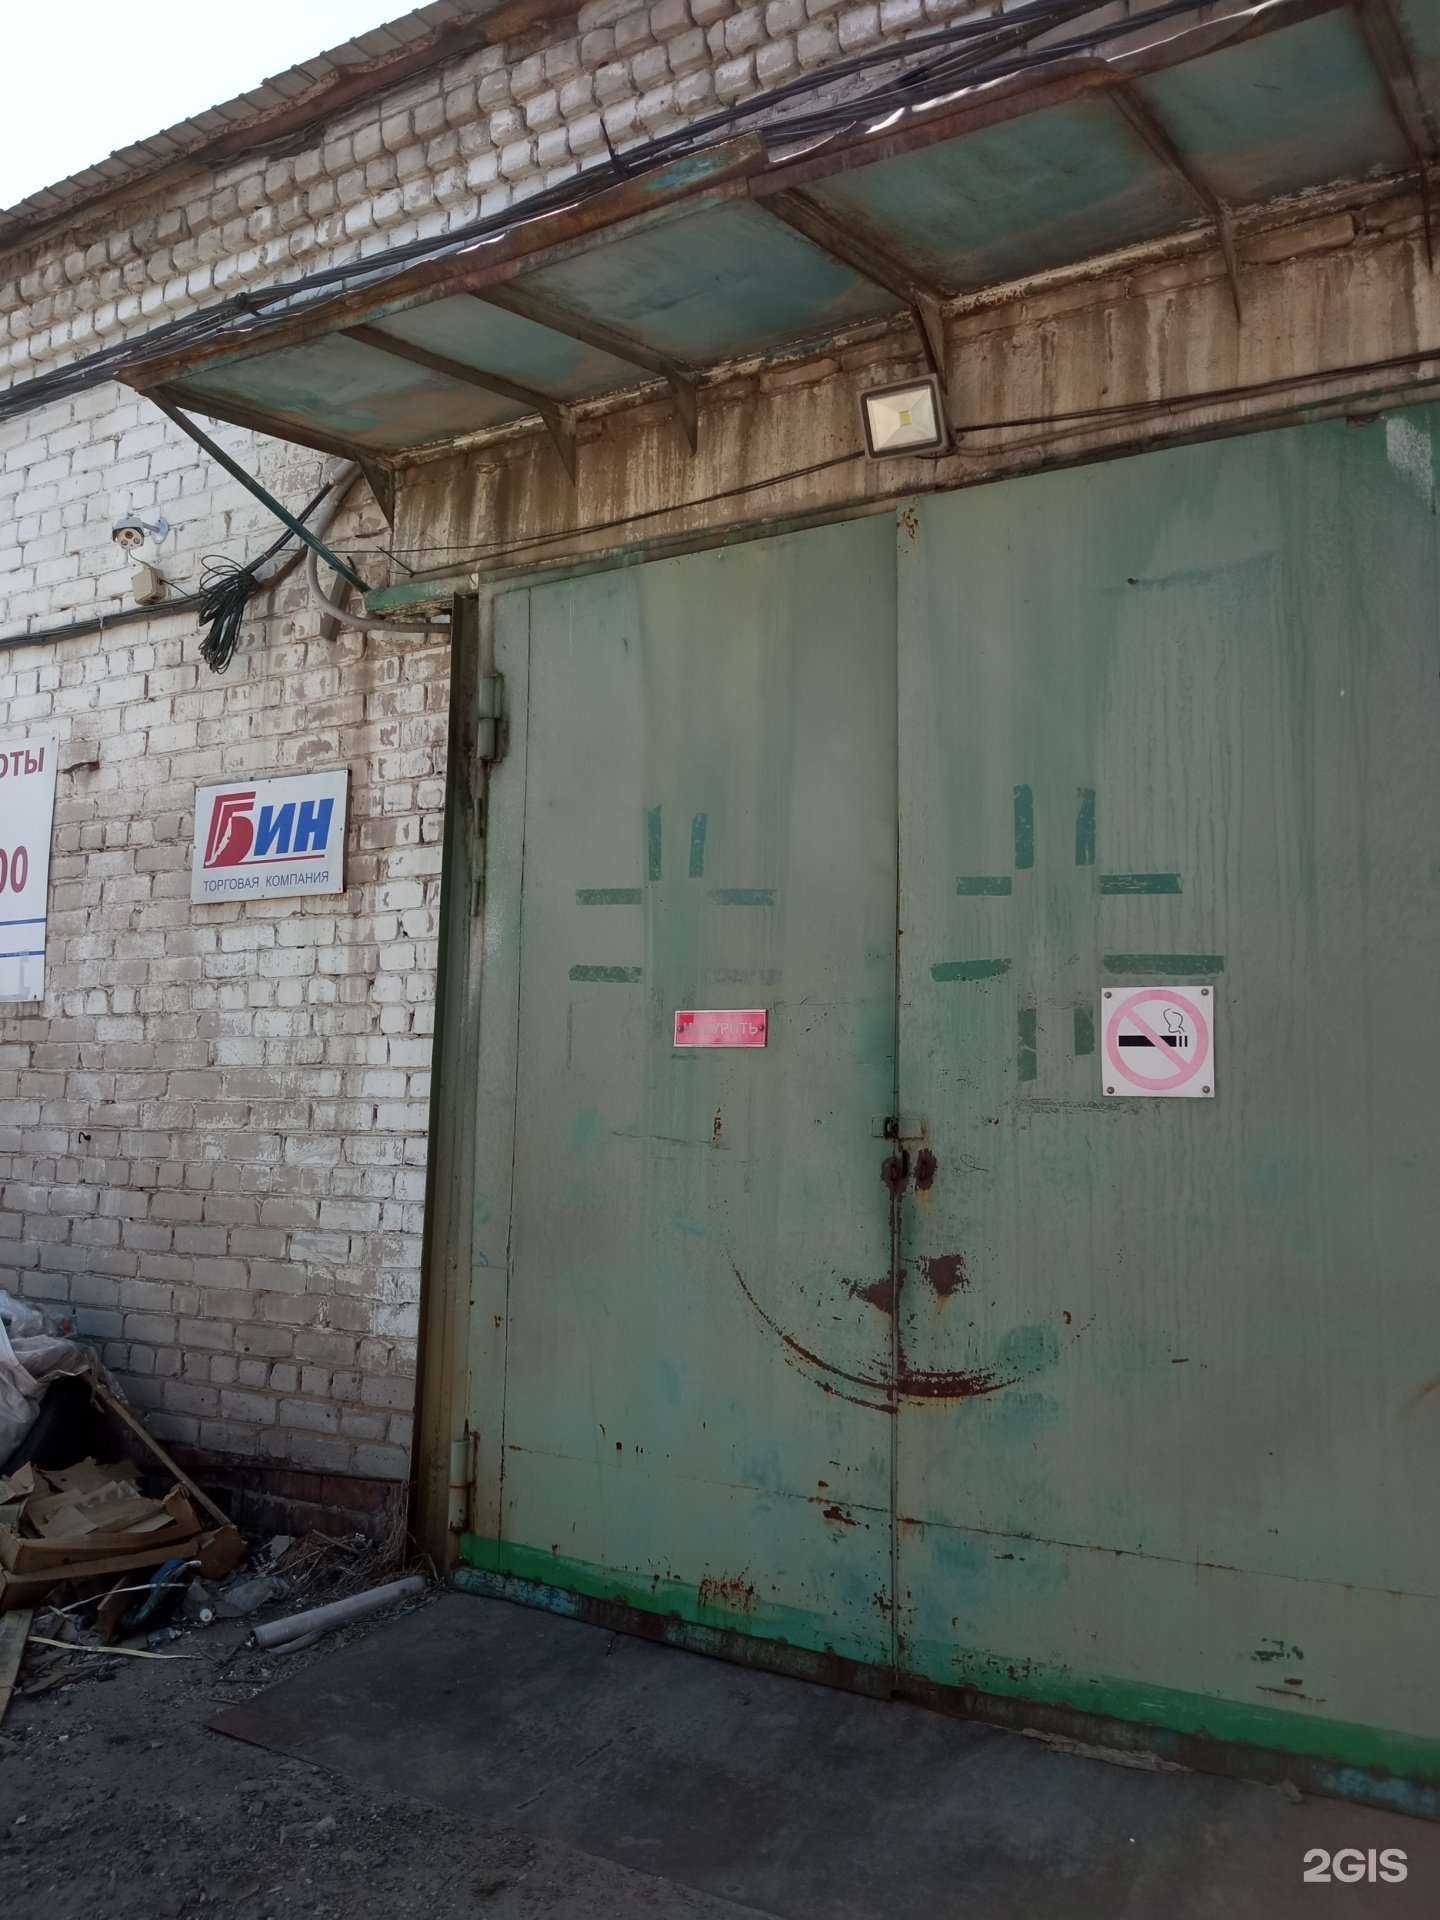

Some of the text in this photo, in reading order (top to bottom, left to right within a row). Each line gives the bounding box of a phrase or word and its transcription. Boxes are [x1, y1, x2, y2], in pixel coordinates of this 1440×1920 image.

[203, 791, 335, 869] БИН
[203, 870, 329, 893] ТОРГОВАЯ КОМПАНИЯ
[706, 1021, 759, 1035] УРИТЬ
